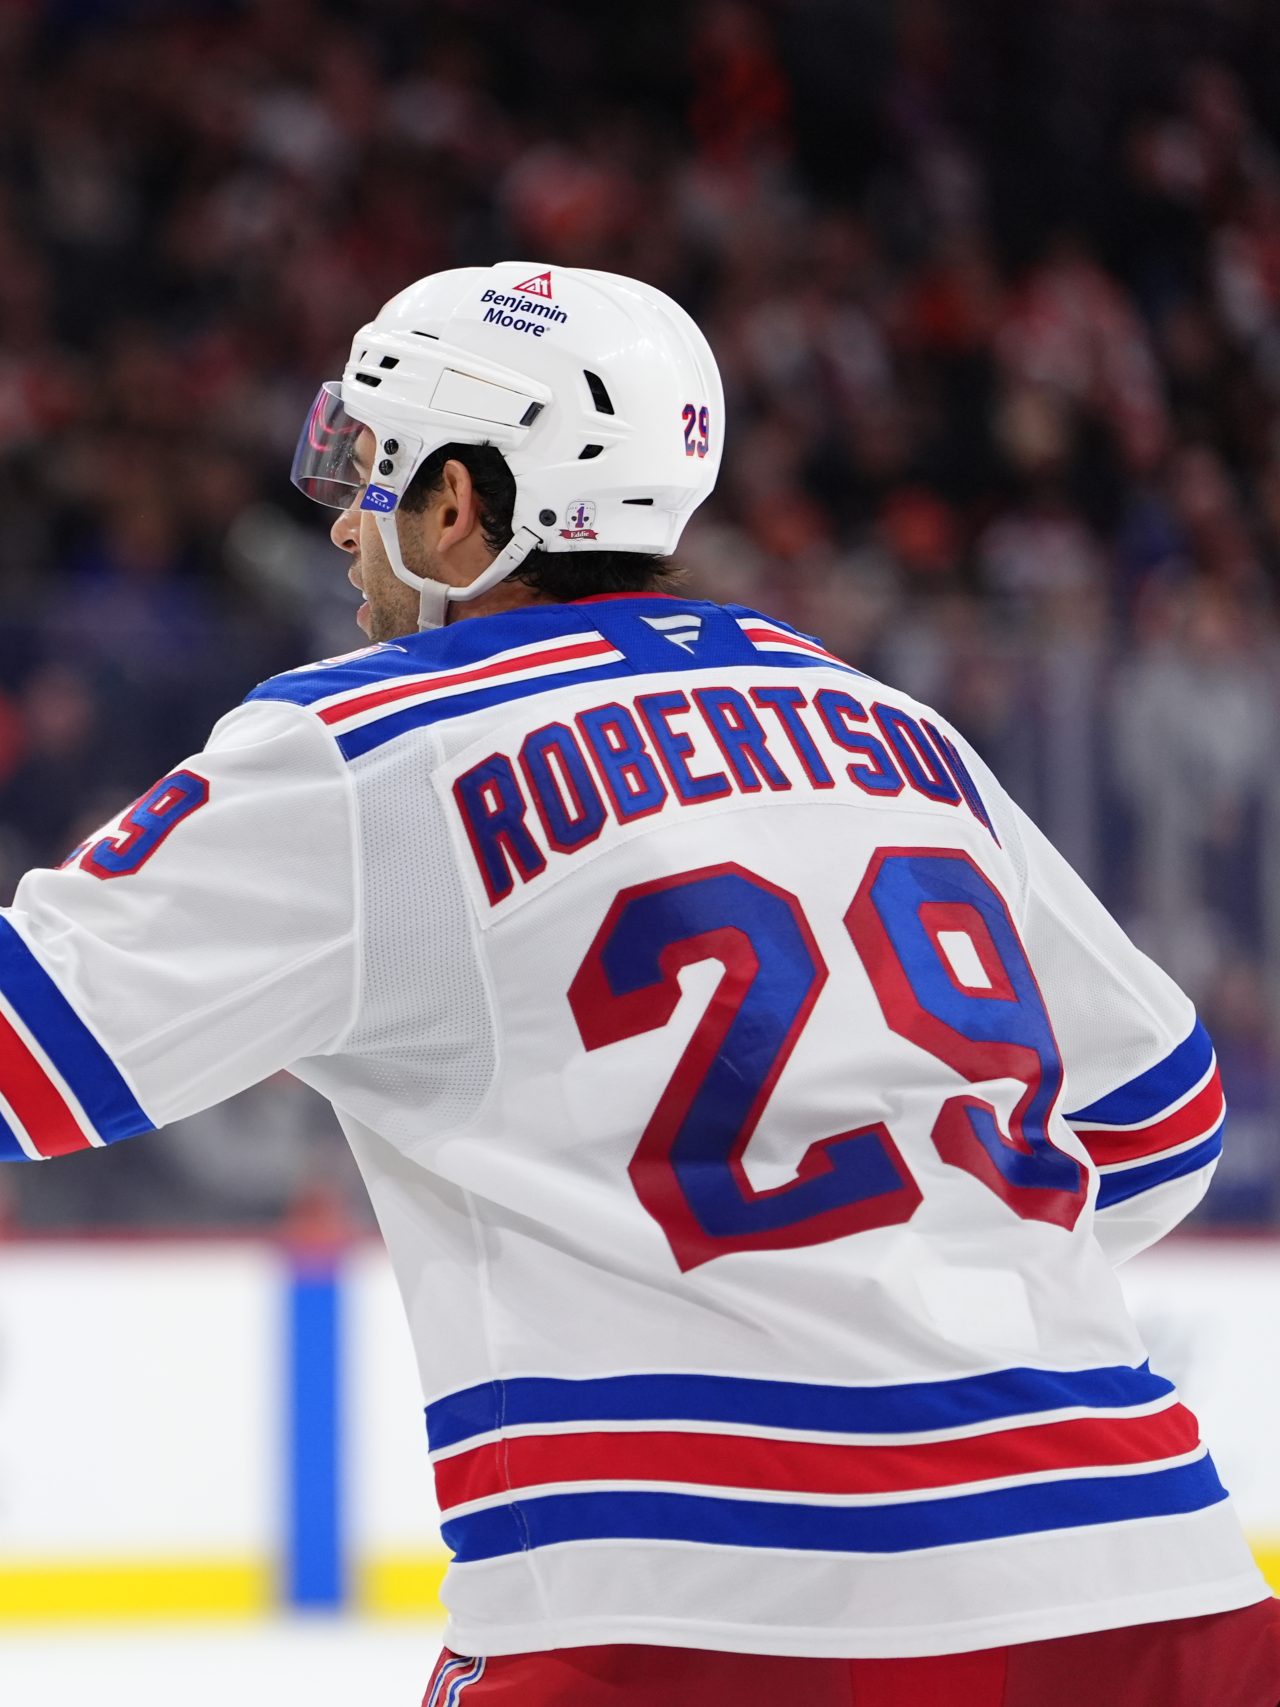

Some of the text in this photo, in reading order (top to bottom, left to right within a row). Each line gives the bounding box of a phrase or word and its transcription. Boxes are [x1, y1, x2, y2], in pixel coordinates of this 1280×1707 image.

[480, 289, 568, 324] Benjamin
[482, 307, 546, 338] Moore
[681, 403, 710, 459] 29
[59, 769, 210, 880] 9
[567, 846, 1089, 1274] 29
